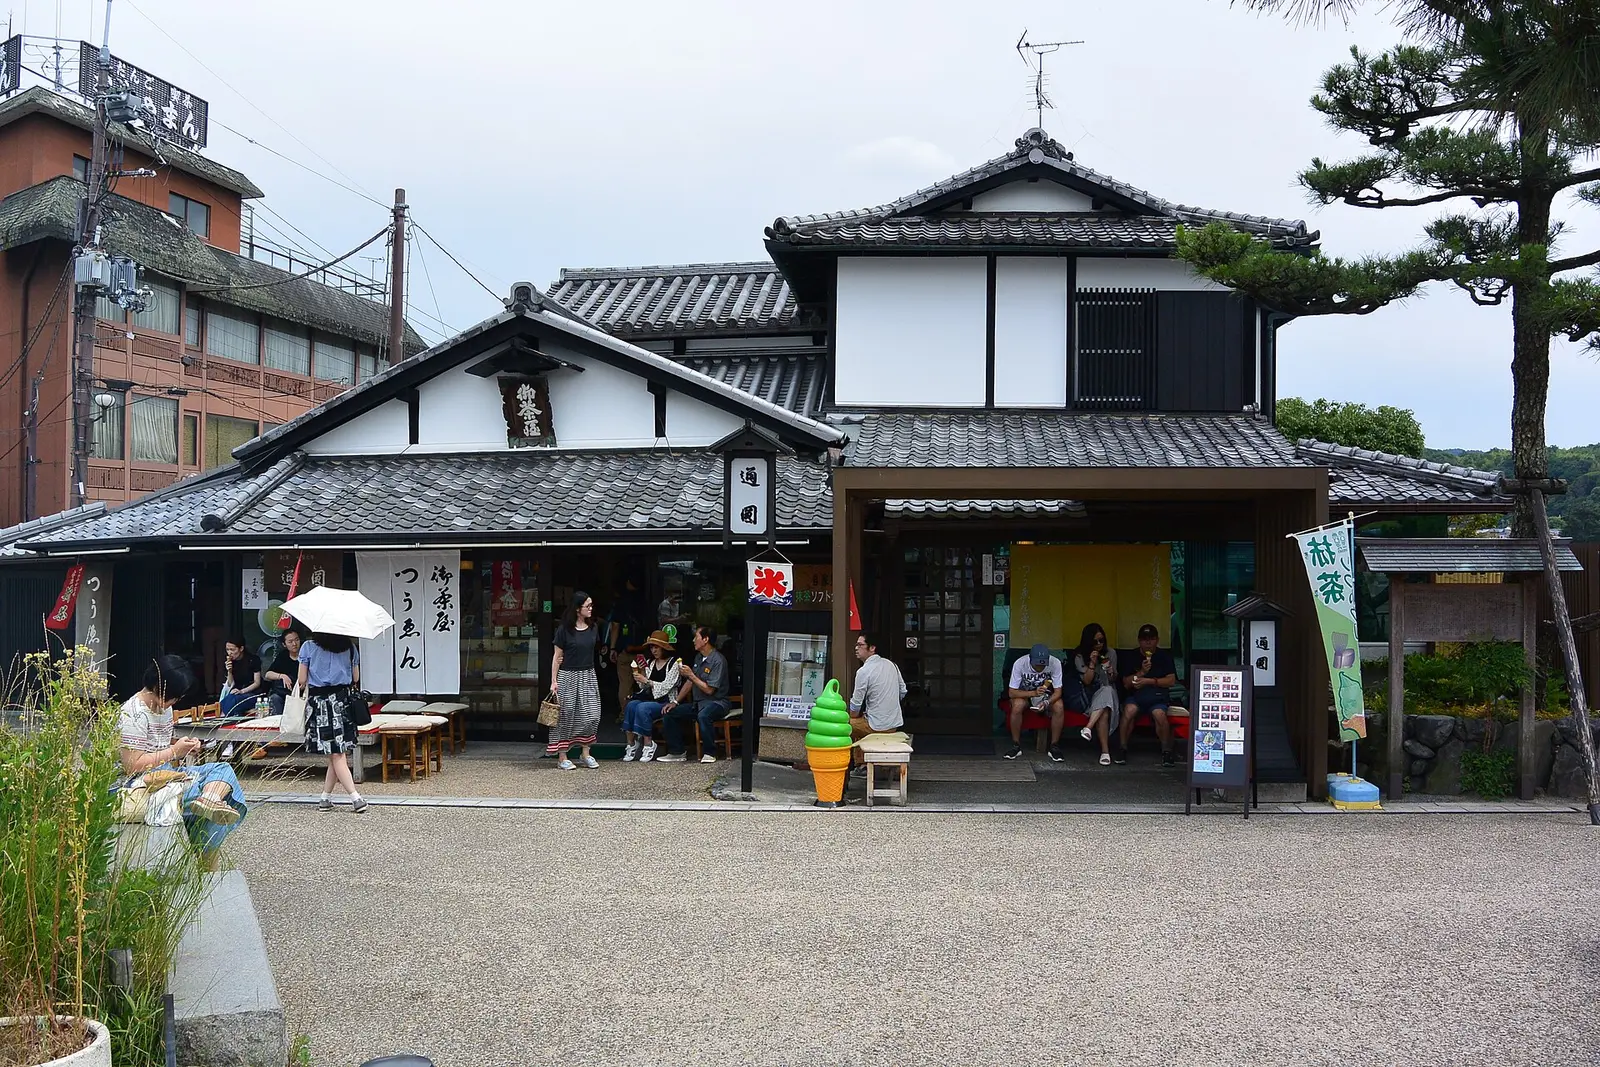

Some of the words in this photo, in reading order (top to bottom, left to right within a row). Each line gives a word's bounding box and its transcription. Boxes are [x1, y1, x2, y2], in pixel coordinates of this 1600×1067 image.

[430, 565, 455, 632] 御茶屋
[753, 567, 787, 598] 氷
[394, 566, 421, 670] つうゑん
[805, 671, 818, 703] 茶だん
